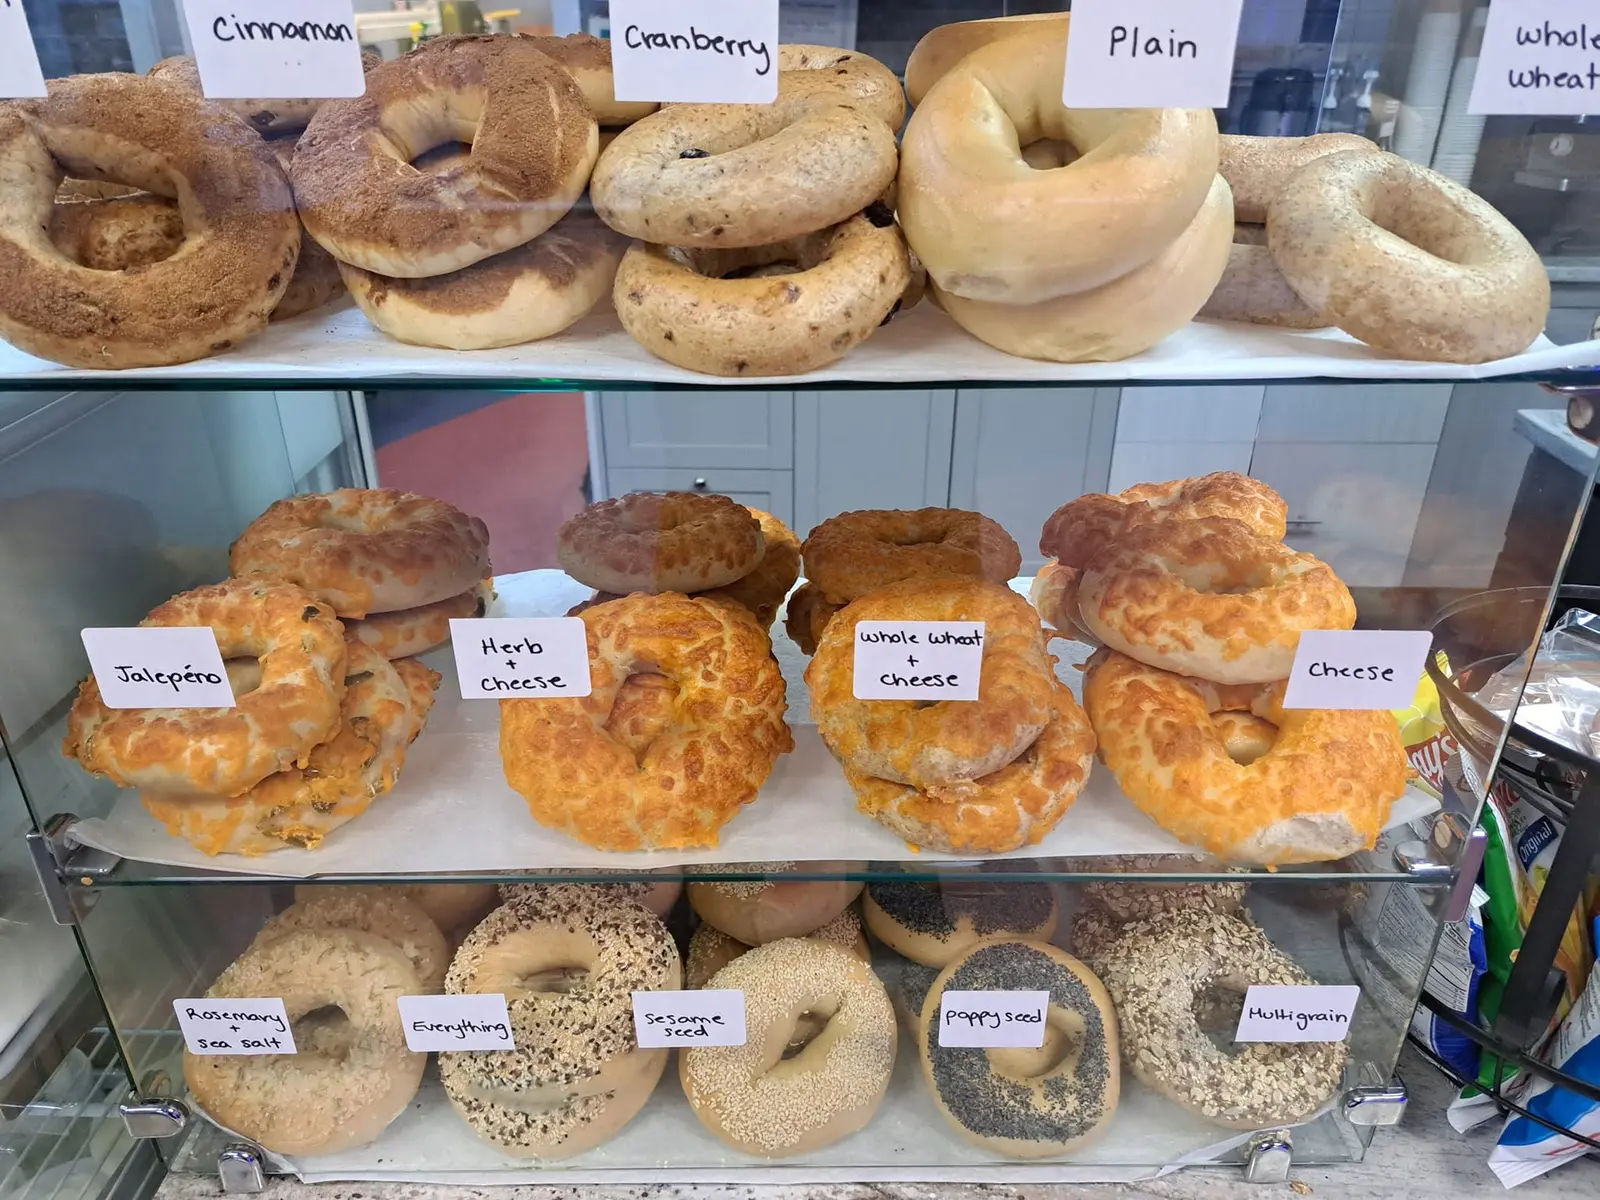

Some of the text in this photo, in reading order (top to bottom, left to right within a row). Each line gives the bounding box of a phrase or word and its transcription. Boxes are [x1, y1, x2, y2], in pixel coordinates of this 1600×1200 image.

[213, 14, 353, 42] Cinnamon
[625, 24, 771, 76] Cranberry
[1110, 25, 1197, 58] Plain
[482, 637, 543, 655] Herb
[1408, 731, 1457, 787] ay's
[186, 1008, 286, 1032] Rosemary
[413, 1019, 510, 1041] Everything
[664, 1024, 709, 1038] seed
[1248, 1007, 1349, 1032] Multigrain
